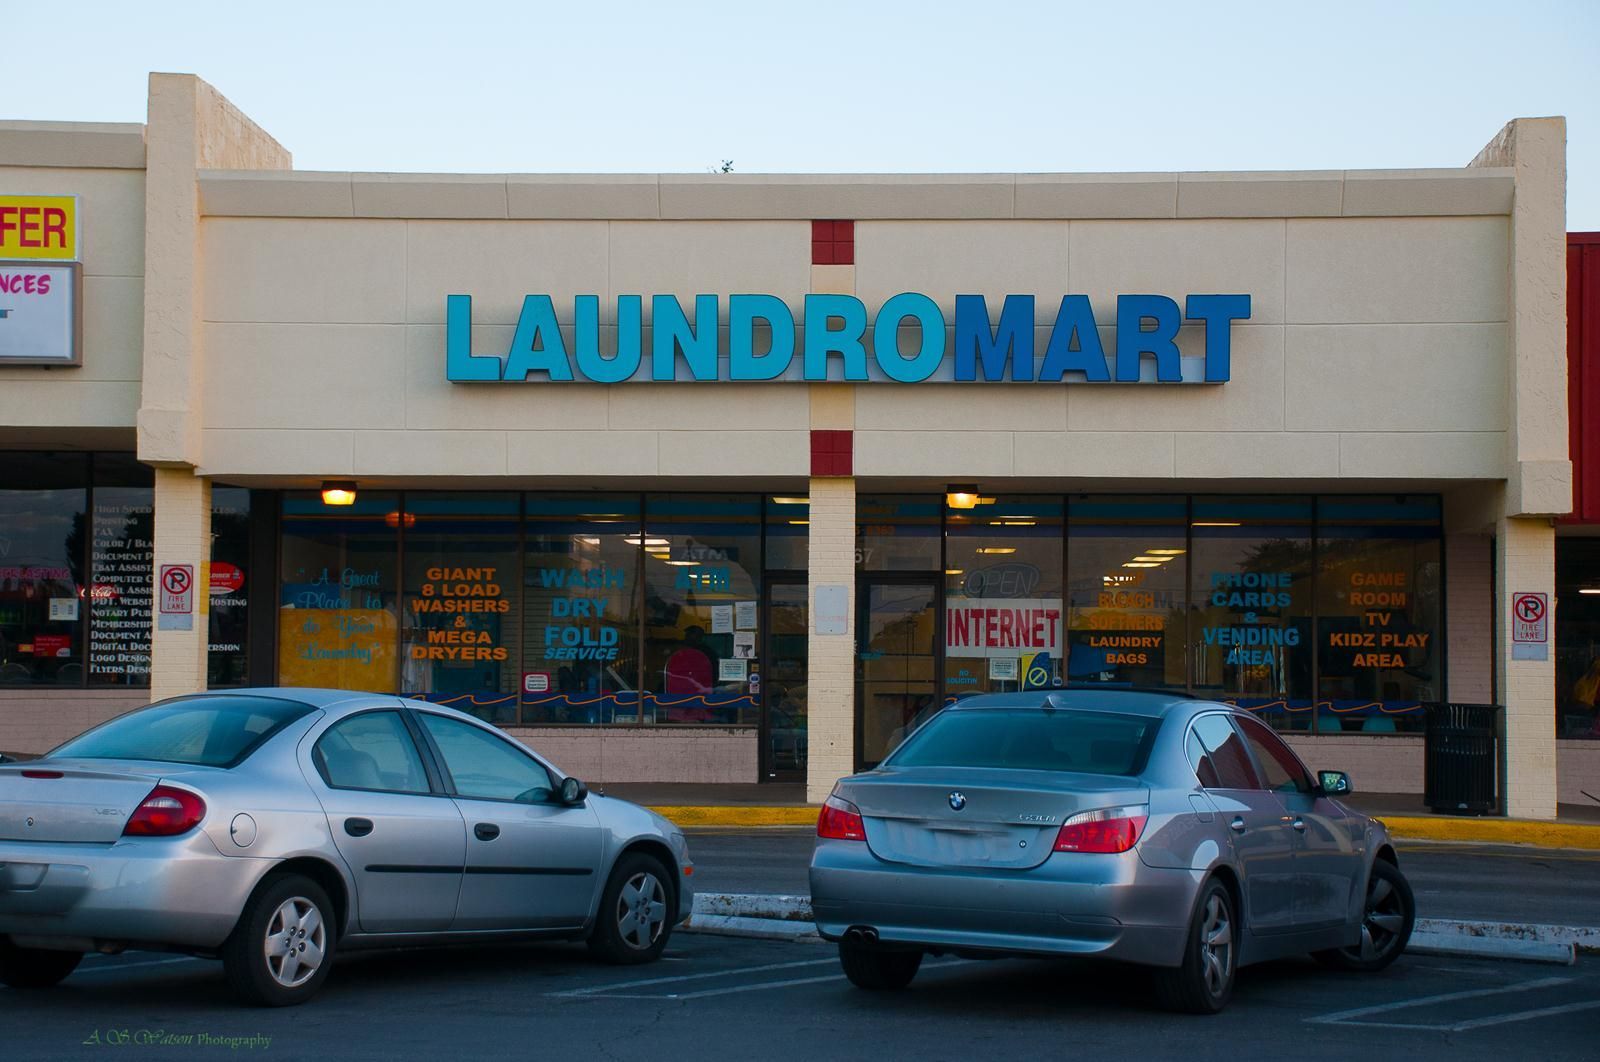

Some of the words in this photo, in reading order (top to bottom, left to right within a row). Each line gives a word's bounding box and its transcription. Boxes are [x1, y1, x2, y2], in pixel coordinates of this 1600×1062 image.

[446, 292, 1251, 384] LAUNDROMART
[93, 540, 124, 548] COLOR
[92, 551, 142, 561] DOCUMENT
[92, 574, 143, 583] COMPUTER
[426, 567, 496, 581] GIANT
[541, 567, 625, 588] WASH
[1211, 572, 1292, 588] PHONE
[1351, 572, 1406, 586] GAME
[967, 570, 1033, 594] OPEN
[442, 584, 500, 597] LOAD
[1211, 592, 1292, 607] CARDS
[1350, 592, 1406, 605] ROOM
[91, 608, 128, 617] NOTARY
[412, 600, 510, 612] WASHERS
[552, 598, 608, 617] DRY
[454, 615, 467, 628] &
[1244, 612, 1258, 624] &
[1366, 612, 1391, 626] TV
[947, 608, 1060, 648] INTERNET
[91, 630, 141, 640] DOCUMENT
[428, 631, 492, 644] MEGA
[543, 627, 618, 646] FOLD
[1202, 626, 1300, 646] VENDING
[1330, 633, 1376, 647] KIDZ
[1381, 634, 1430, 647] PLAY
[1520, 632, 1539, 640] LANE
[90, 642, 128, 651] DIGITAL
[1090, 637, 1162, 648] LAUNDRY
[90, 653, 116, 663] LOGO
[412, 647, 508, 661] DRYERS
[543, 648, 618, 660] SERVICE
[1106, 654, 1148, 664] BAGS
[1227, 650, 1273, 665] AREA
[1353, 654, 1405, 668] AREA
[90, 664, 125, 674] FLYERS
